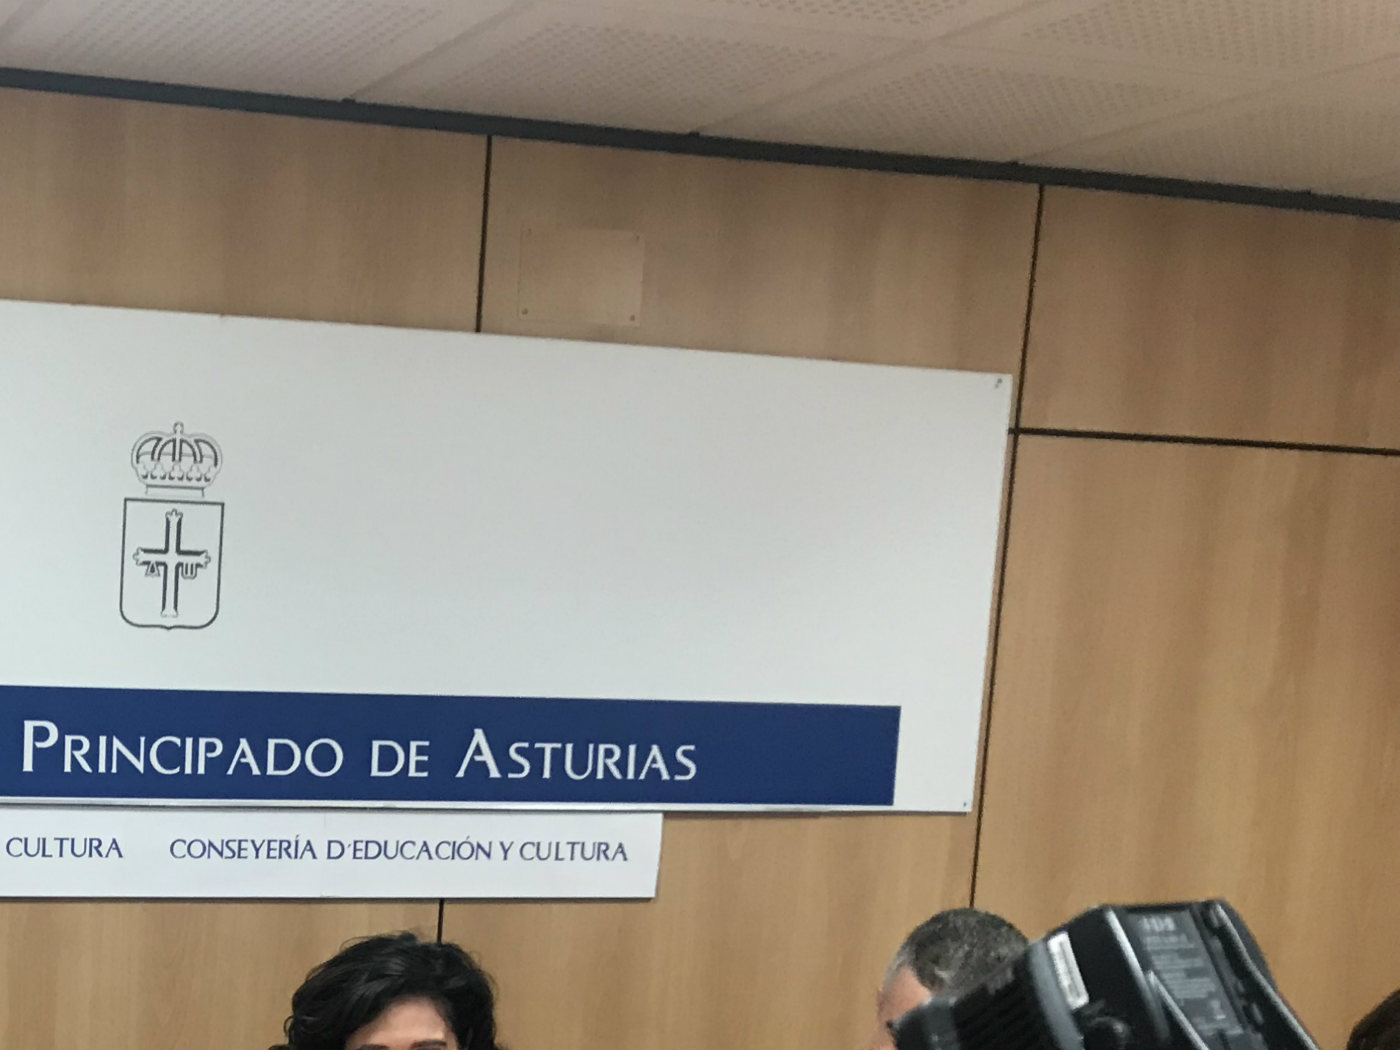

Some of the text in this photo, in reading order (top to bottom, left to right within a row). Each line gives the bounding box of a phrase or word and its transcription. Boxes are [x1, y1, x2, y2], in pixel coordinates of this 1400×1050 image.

[22, 720, 344, 777] PRINCIPADO
[370, 740, 430, 777] DE
[455, 728, 697, 781] ASTURIAS
[5, 837, 124, 859] CULTURA
[169, 834, 318, 860] CONSEYERÍA
[499, 841, 514, 861] Y
[519, 841, 629, 862] CULTURA
